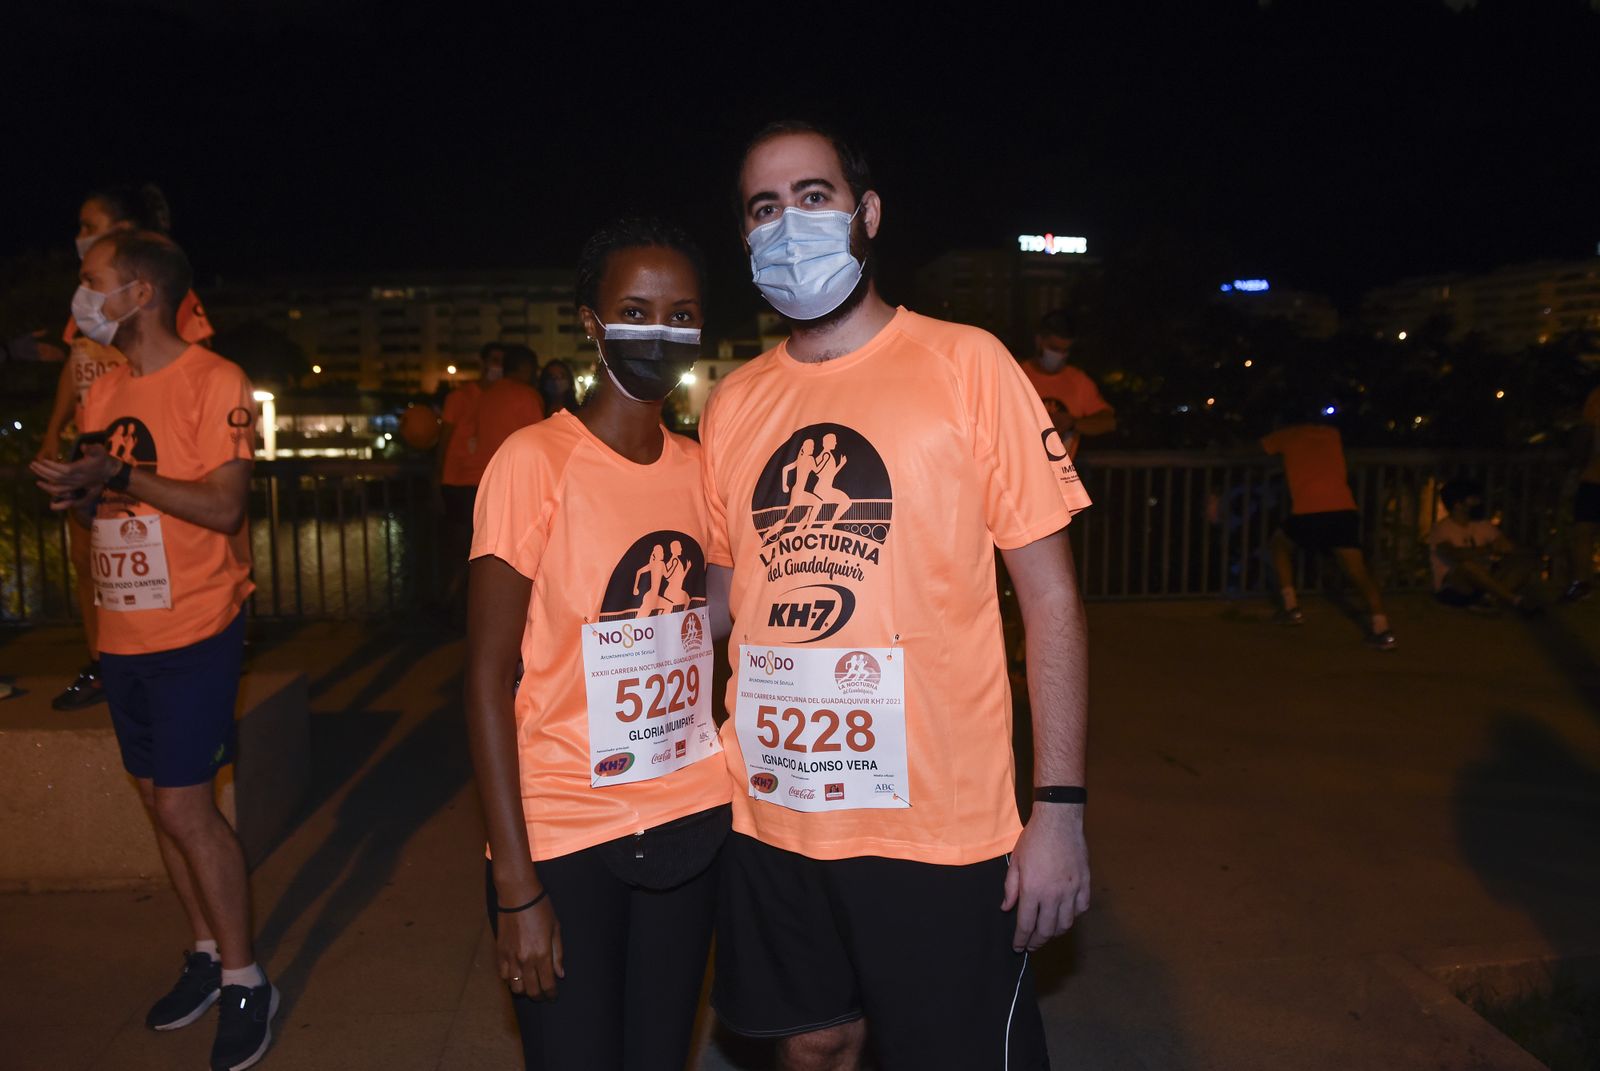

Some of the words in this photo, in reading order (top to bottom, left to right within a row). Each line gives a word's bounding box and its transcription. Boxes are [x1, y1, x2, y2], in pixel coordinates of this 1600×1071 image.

[779, 534, 880, 565] NOCTURNA
[767, 562, 783, 582] del
[784, 556, 864, 582] Guadalquivir
[134, 578, 167, 588] CANTERO
[610, 666, 638, 675] CARRERA
[616, 664, 700, 723] 5229
[777, 695, 807, 703] NOCTURNA
[629, 725, 665, 741] GLORIA
[757, 705, 876, 753] 5228
[762, 754, 796, 771] IGNACIO
[798, 760, 843, 773] ALONSO
[846, 760, 878, 771] VERA
[875, 783, 895, 791] ABC
